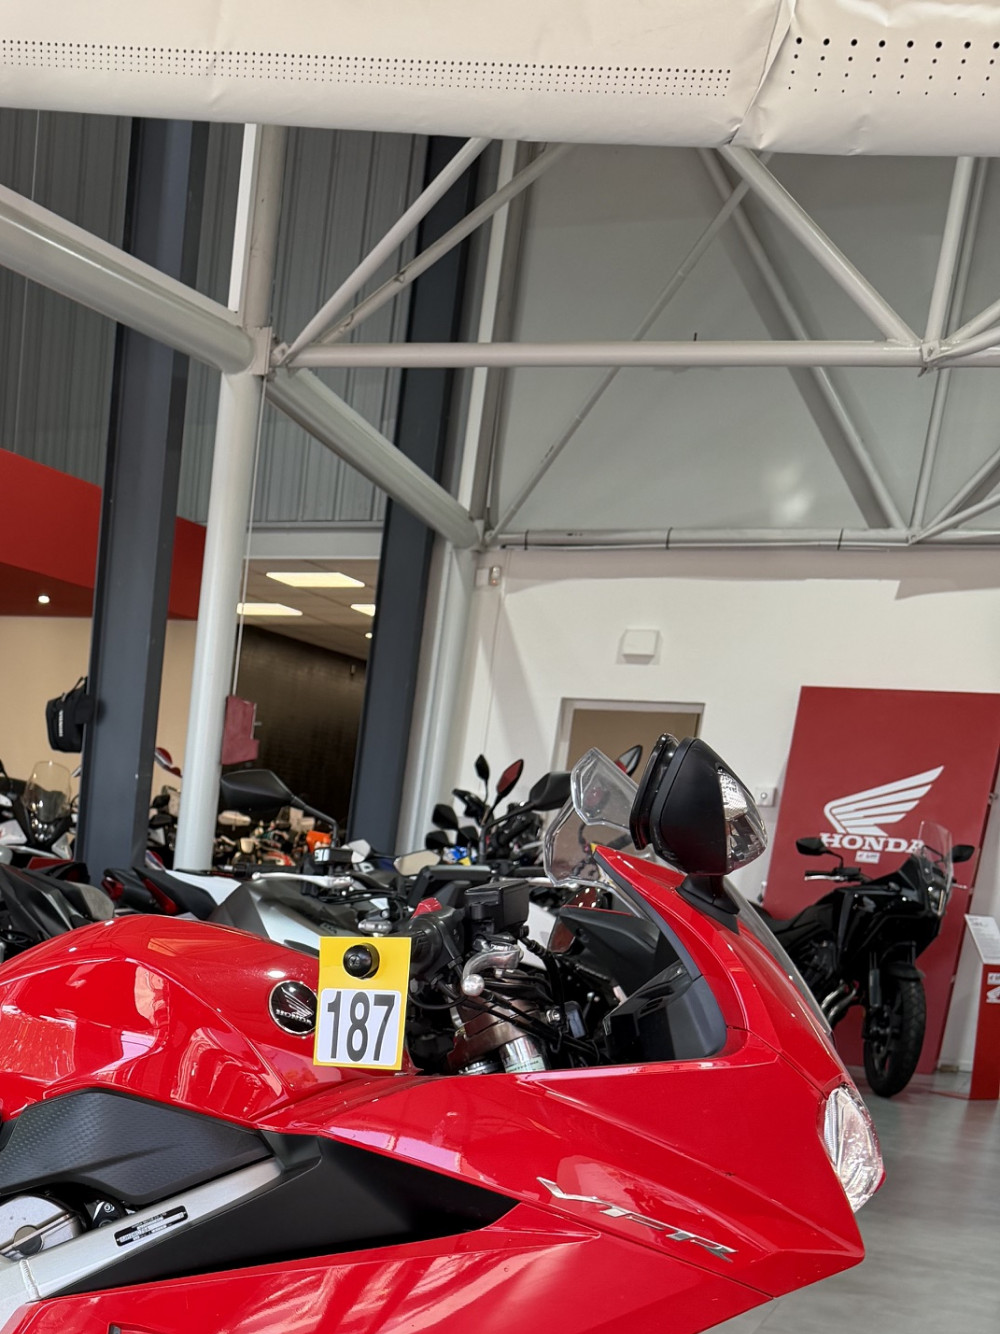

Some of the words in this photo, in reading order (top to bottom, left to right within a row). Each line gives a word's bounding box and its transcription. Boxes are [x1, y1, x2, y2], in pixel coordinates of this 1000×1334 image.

[819, 832, 925, 854] HONDA
[275, 1008, 313, 1026] HONDA
[327, 991, 395, 1062] 187
[536, 1176, 738, 1263] VFR
